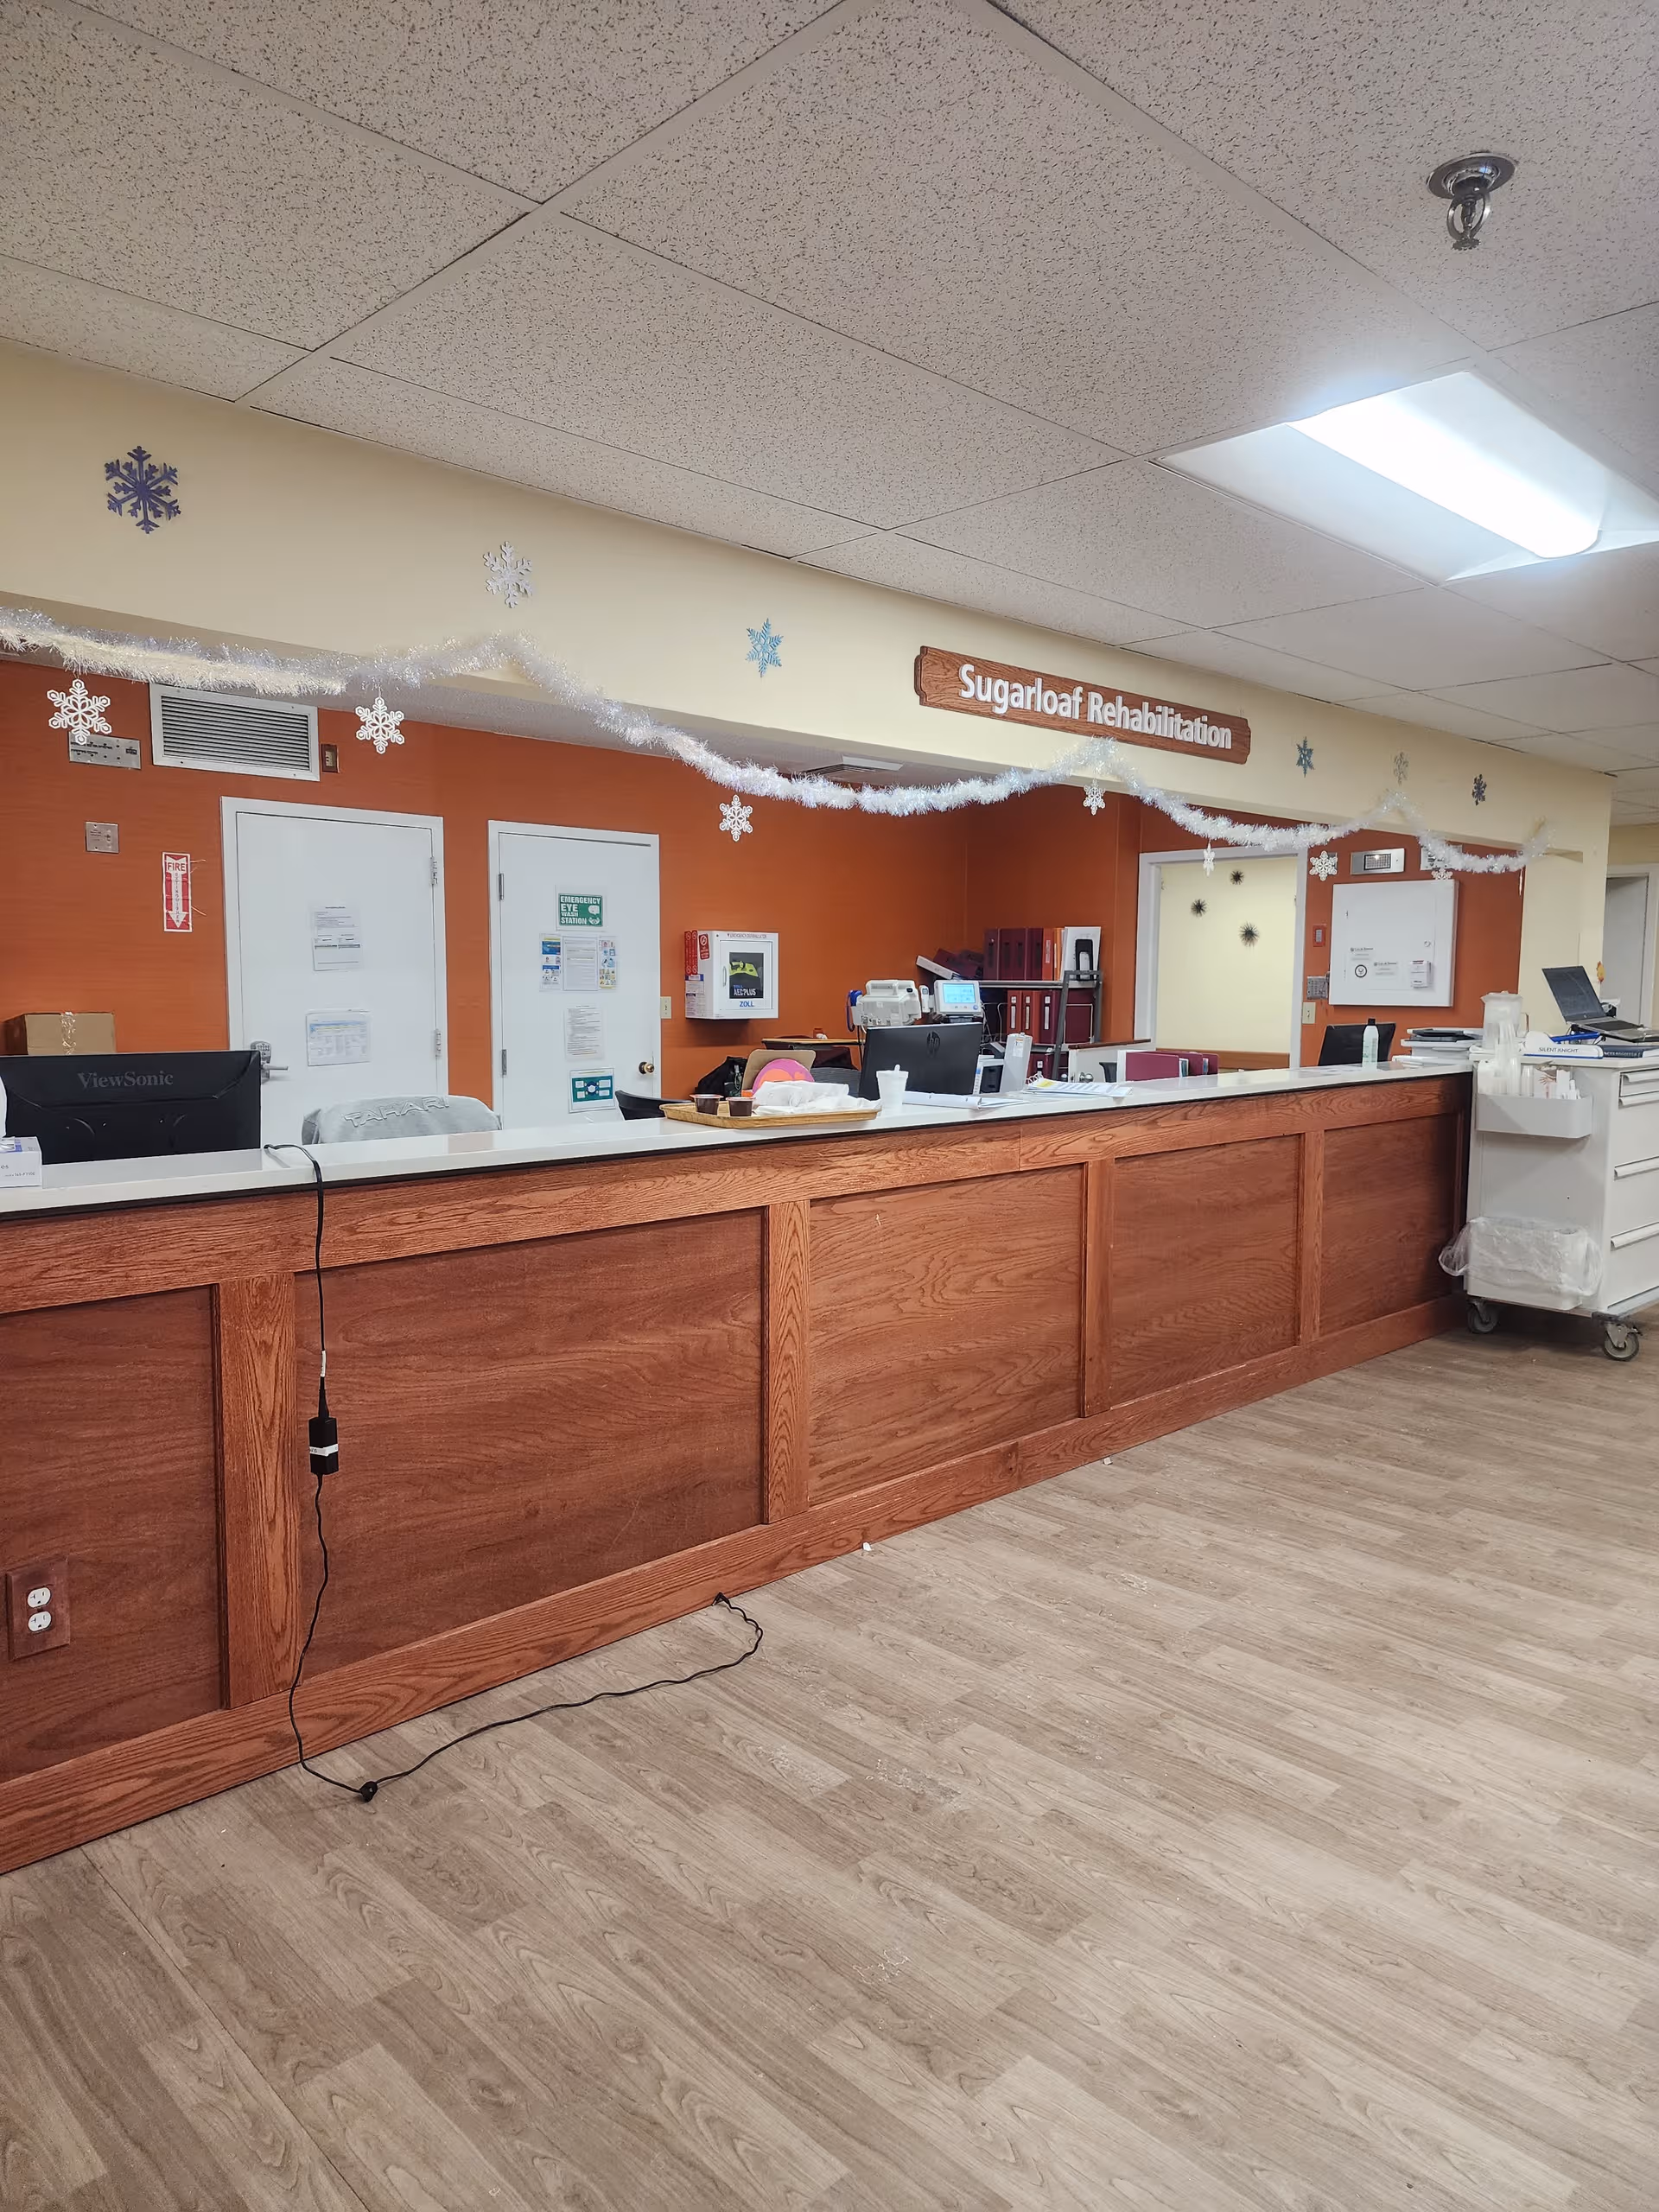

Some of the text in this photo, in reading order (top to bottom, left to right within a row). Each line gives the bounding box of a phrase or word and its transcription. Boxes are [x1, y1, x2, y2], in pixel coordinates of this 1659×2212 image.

[958, 664, 1232, 750] Sugarloaf Rehabilitation
[167, 862, 186, 872] FIRE
[560, 895, 601, 905] EMERGENCY
[561, 903, 579, 912] EYE
[77, 1071, 174, 1089] ViewSonic
[344, 1096, 449, 1128] TAHARI
